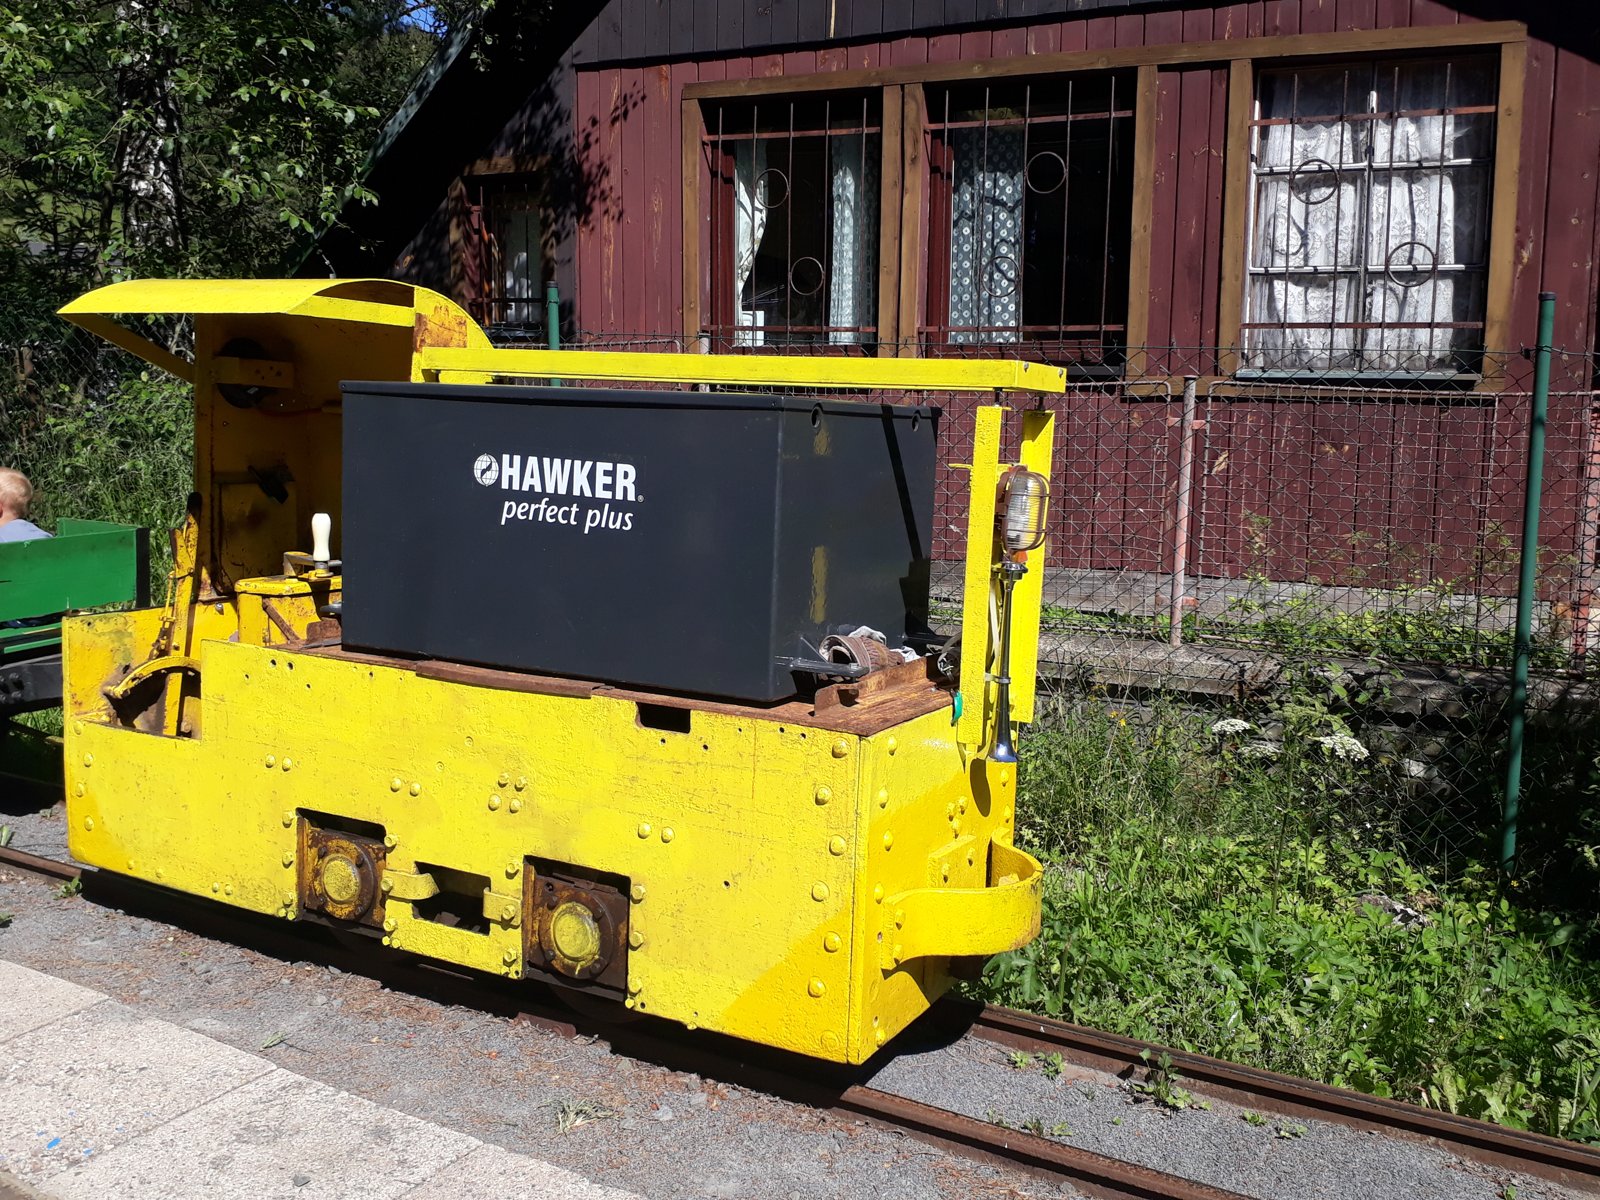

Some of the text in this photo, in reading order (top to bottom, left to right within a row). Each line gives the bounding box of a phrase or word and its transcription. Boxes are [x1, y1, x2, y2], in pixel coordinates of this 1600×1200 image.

[502, 453, 637, 502] HAWKER
[500, 498, 634, 534] perfect plus
